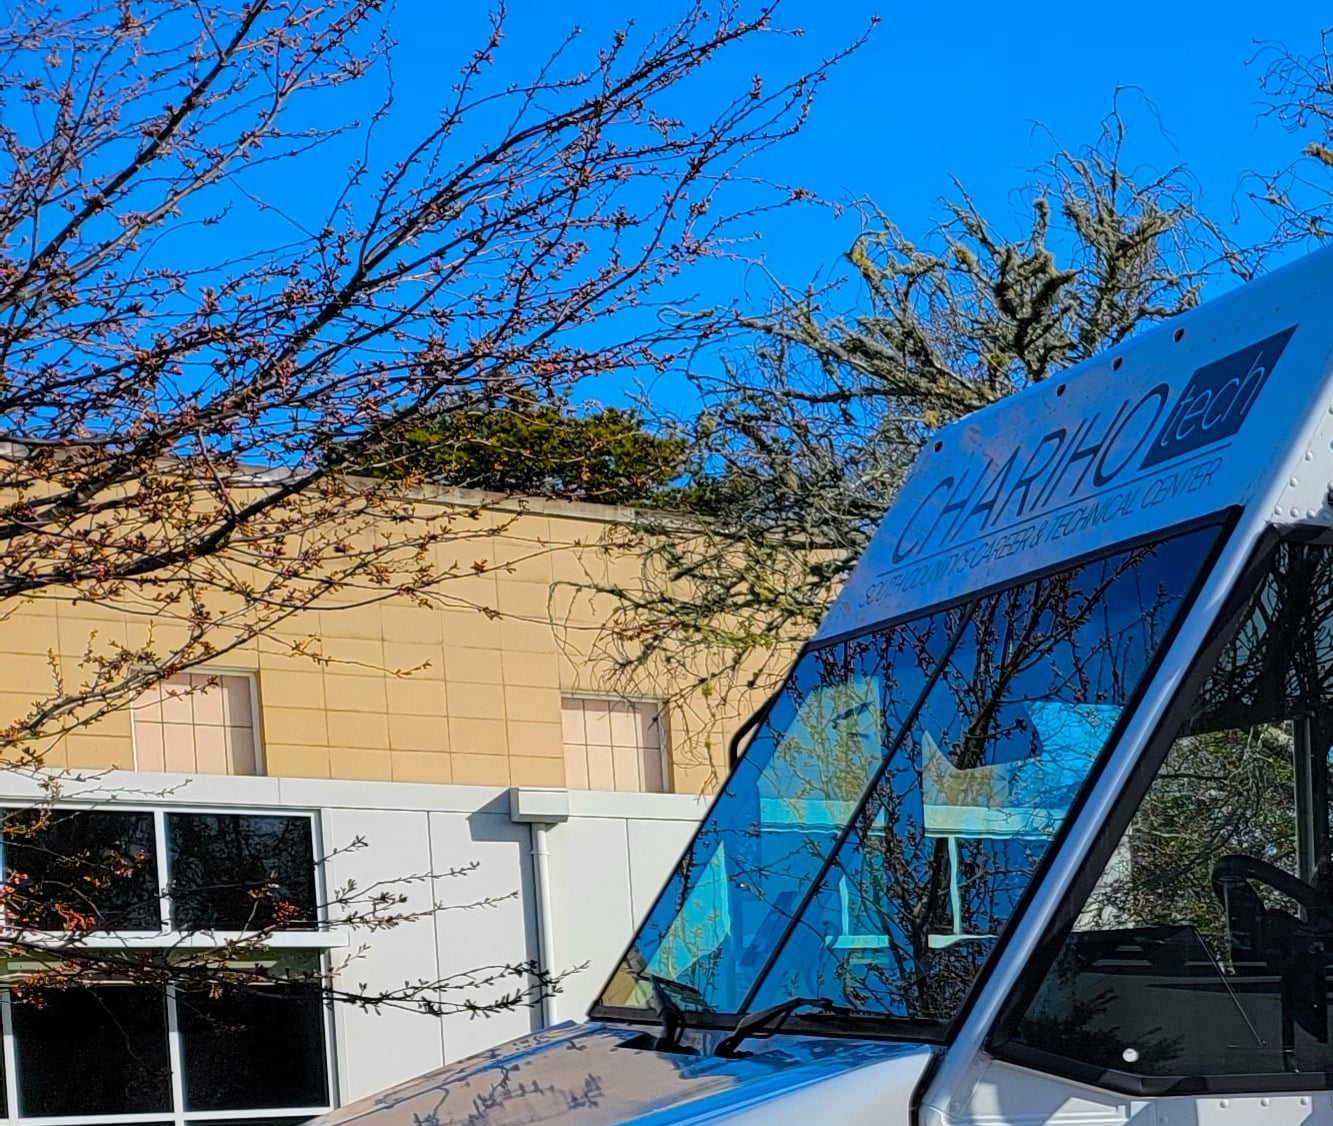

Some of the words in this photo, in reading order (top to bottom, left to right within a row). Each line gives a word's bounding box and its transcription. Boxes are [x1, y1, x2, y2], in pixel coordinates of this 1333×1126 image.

[891, 382, 1169, 565] CHARIHO
[1159, 350, 1266, 447] tech
[1043, 487, 1139, 543] TECHNICAL
[1139, 456, 1223, 510] CENTER
